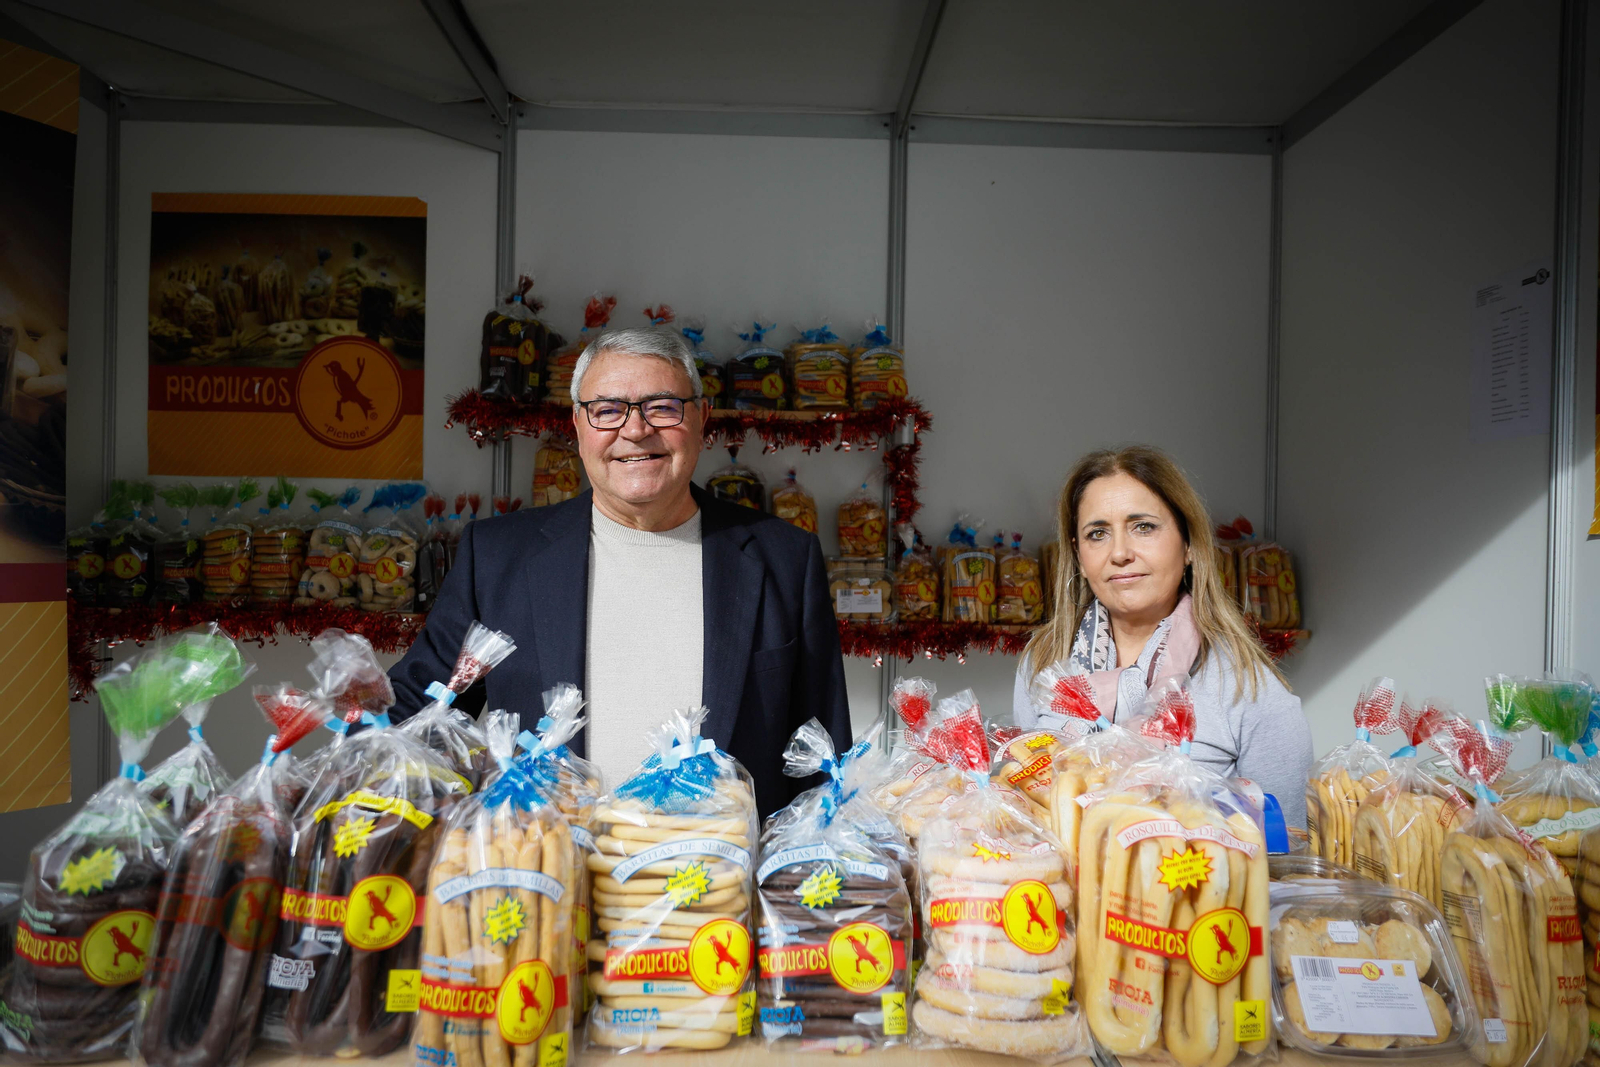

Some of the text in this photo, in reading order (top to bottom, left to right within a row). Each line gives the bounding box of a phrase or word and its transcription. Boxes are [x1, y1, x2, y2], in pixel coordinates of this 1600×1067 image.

[166, 375, 292, 407] PRODUCTOS
[324, 423, 369, 440] "Pichote"
[1124, 822, 1193, 843] ROSQUILLAS
[1199, 826, 1216, 838] DE
[616, 845, 674, 880] BARRITAS
[679, 842, 696, 853] DE
[758, 847, 885, 879] BARRITAS DE MILLAS
[931, 900, 1001, 925] PRODUCTOS
[1108, 916, 1187, 955] PRODUCTOS
[606, 949, 688, 977] PRODUCTOS
[760, 947, 828, 974] PRODUCTOS
[420, 982, 496, 1015] PRODUCTOS
[1109, 978, 1154, 1005] RIOJA
[612, 1007, 662, 1025] RIOJA
[760, 1006, 806, 1024] RIOJA
